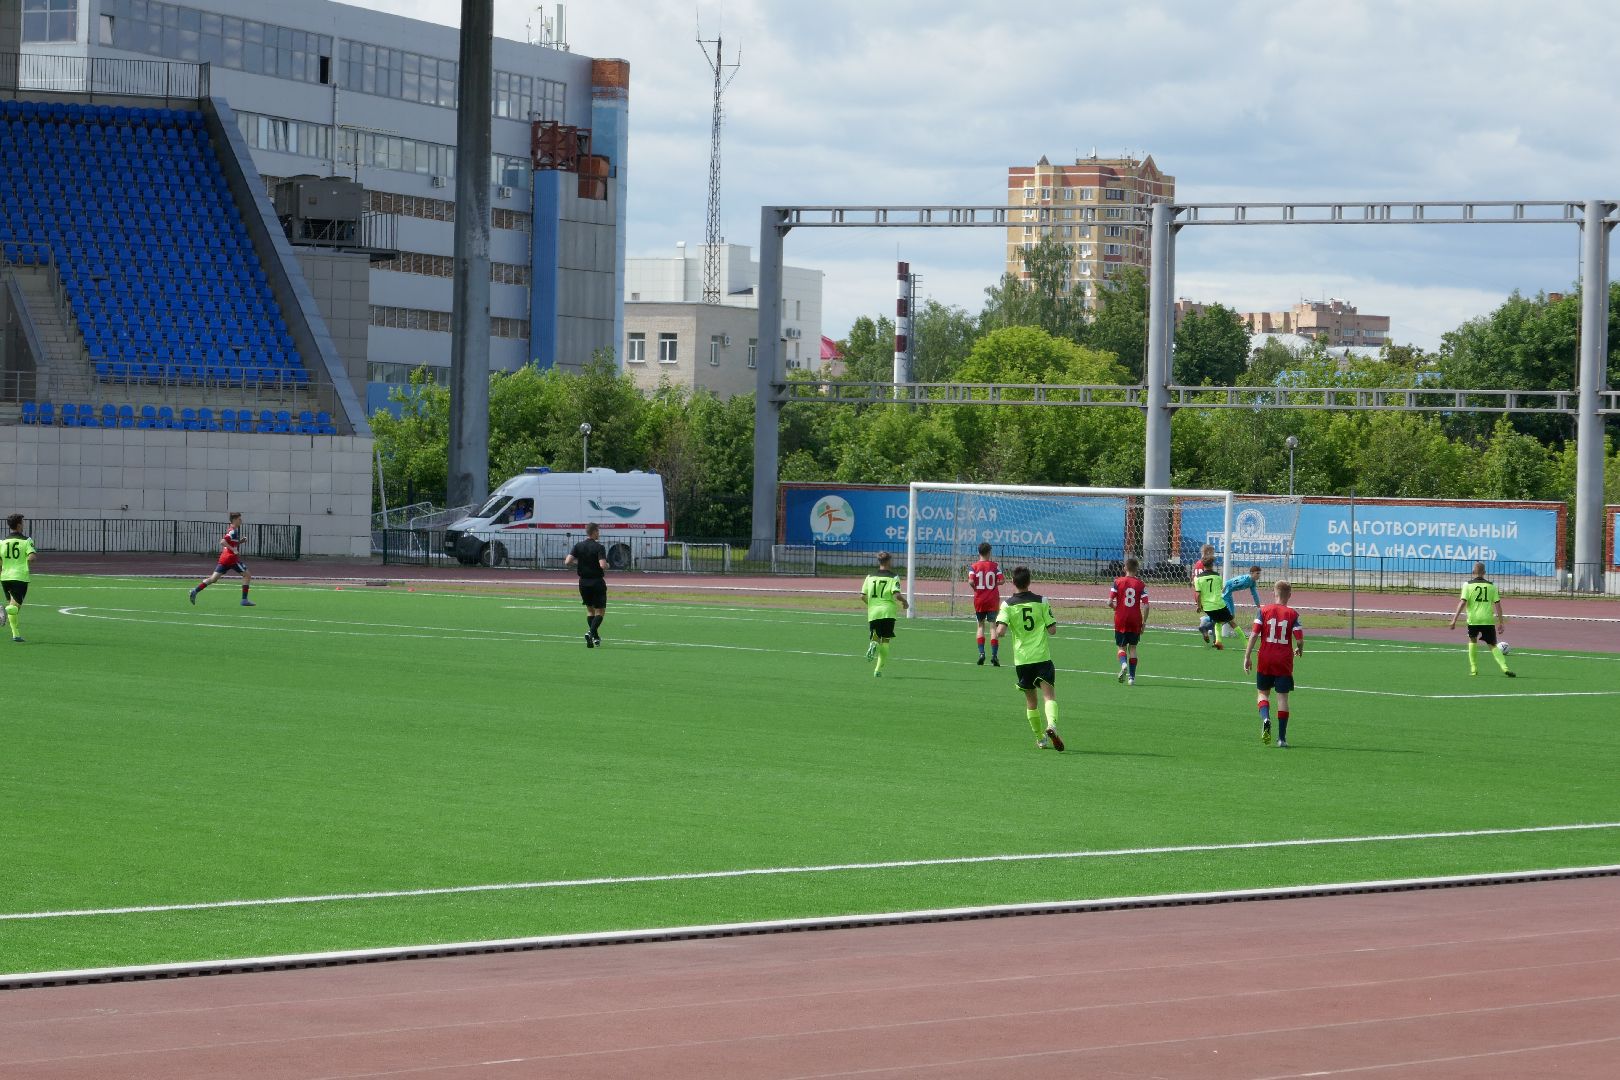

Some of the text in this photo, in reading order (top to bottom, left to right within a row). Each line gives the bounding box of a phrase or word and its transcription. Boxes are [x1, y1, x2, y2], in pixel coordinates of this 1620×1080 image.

[982, 529, 1056, 545] ФУТБОЛА
[1328, 520, 1518, 538] БЛАГОТВОРИТЕЛЬНЫЙ
[5, 542, 20, 559] 16
[1327, 541, 1497, 561] ФОНД «НАСЛЕДИЕ»
[872, 580, 887, 598] 17
[976, 571, 996, 590] 10
[1206, 578, 1213, 592] 7
[1124, 588, 1136, 607] 8
[1475, 586, 1489, 602] 21
[1022, 607, 1035, 632] 5
[1265, 618, 1289, 645] 11
